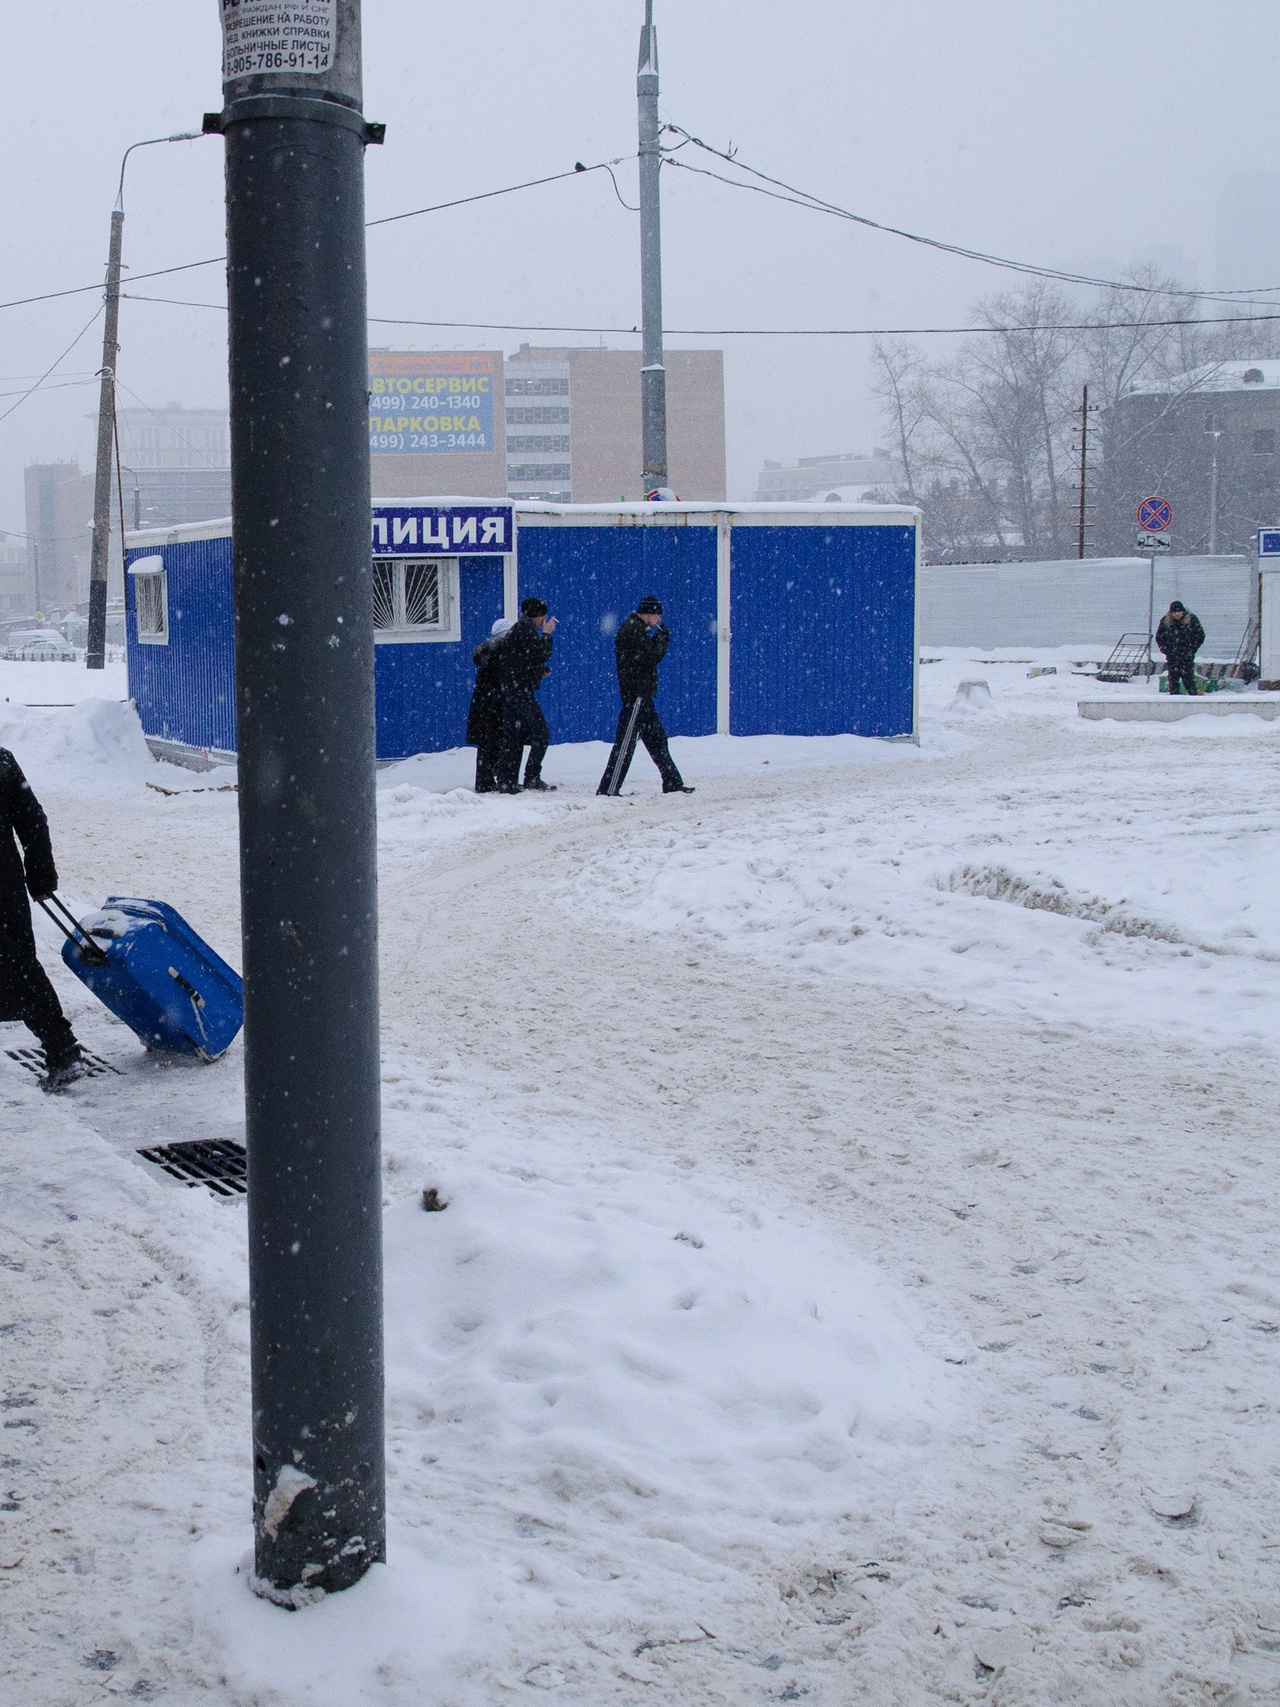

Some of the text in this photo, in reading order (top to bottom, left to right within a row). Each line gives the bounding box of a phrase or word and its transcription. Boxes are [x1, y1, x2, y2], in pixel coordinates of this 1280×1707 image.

[284, 3, 299, 11] РФ
[311, 5, 330, 14] СНГ
[225, 13, 330, 33] РАЗРЕШЕНИЕ НА РАБОТУ
[241, 27, 280, 40] КНИЖКИ
[282, 27, 330, 39] СПРАВКИ
[227, 40, 331, 59] БОЛЬНИЧНЫЕ ЛИСТЫ
[227, 52, 329, 77] 8-905-786-91-14
[371, 376, 489, 394] ВТОСЕРВИС
[411, 395, 481, 410] 240-1340
[368, 415, 482, 432] ПАРКОВКА
[369, 433, 486, 450] 499) 243-3444
[371, 516, 505, 549] ЛИЦИЯ
